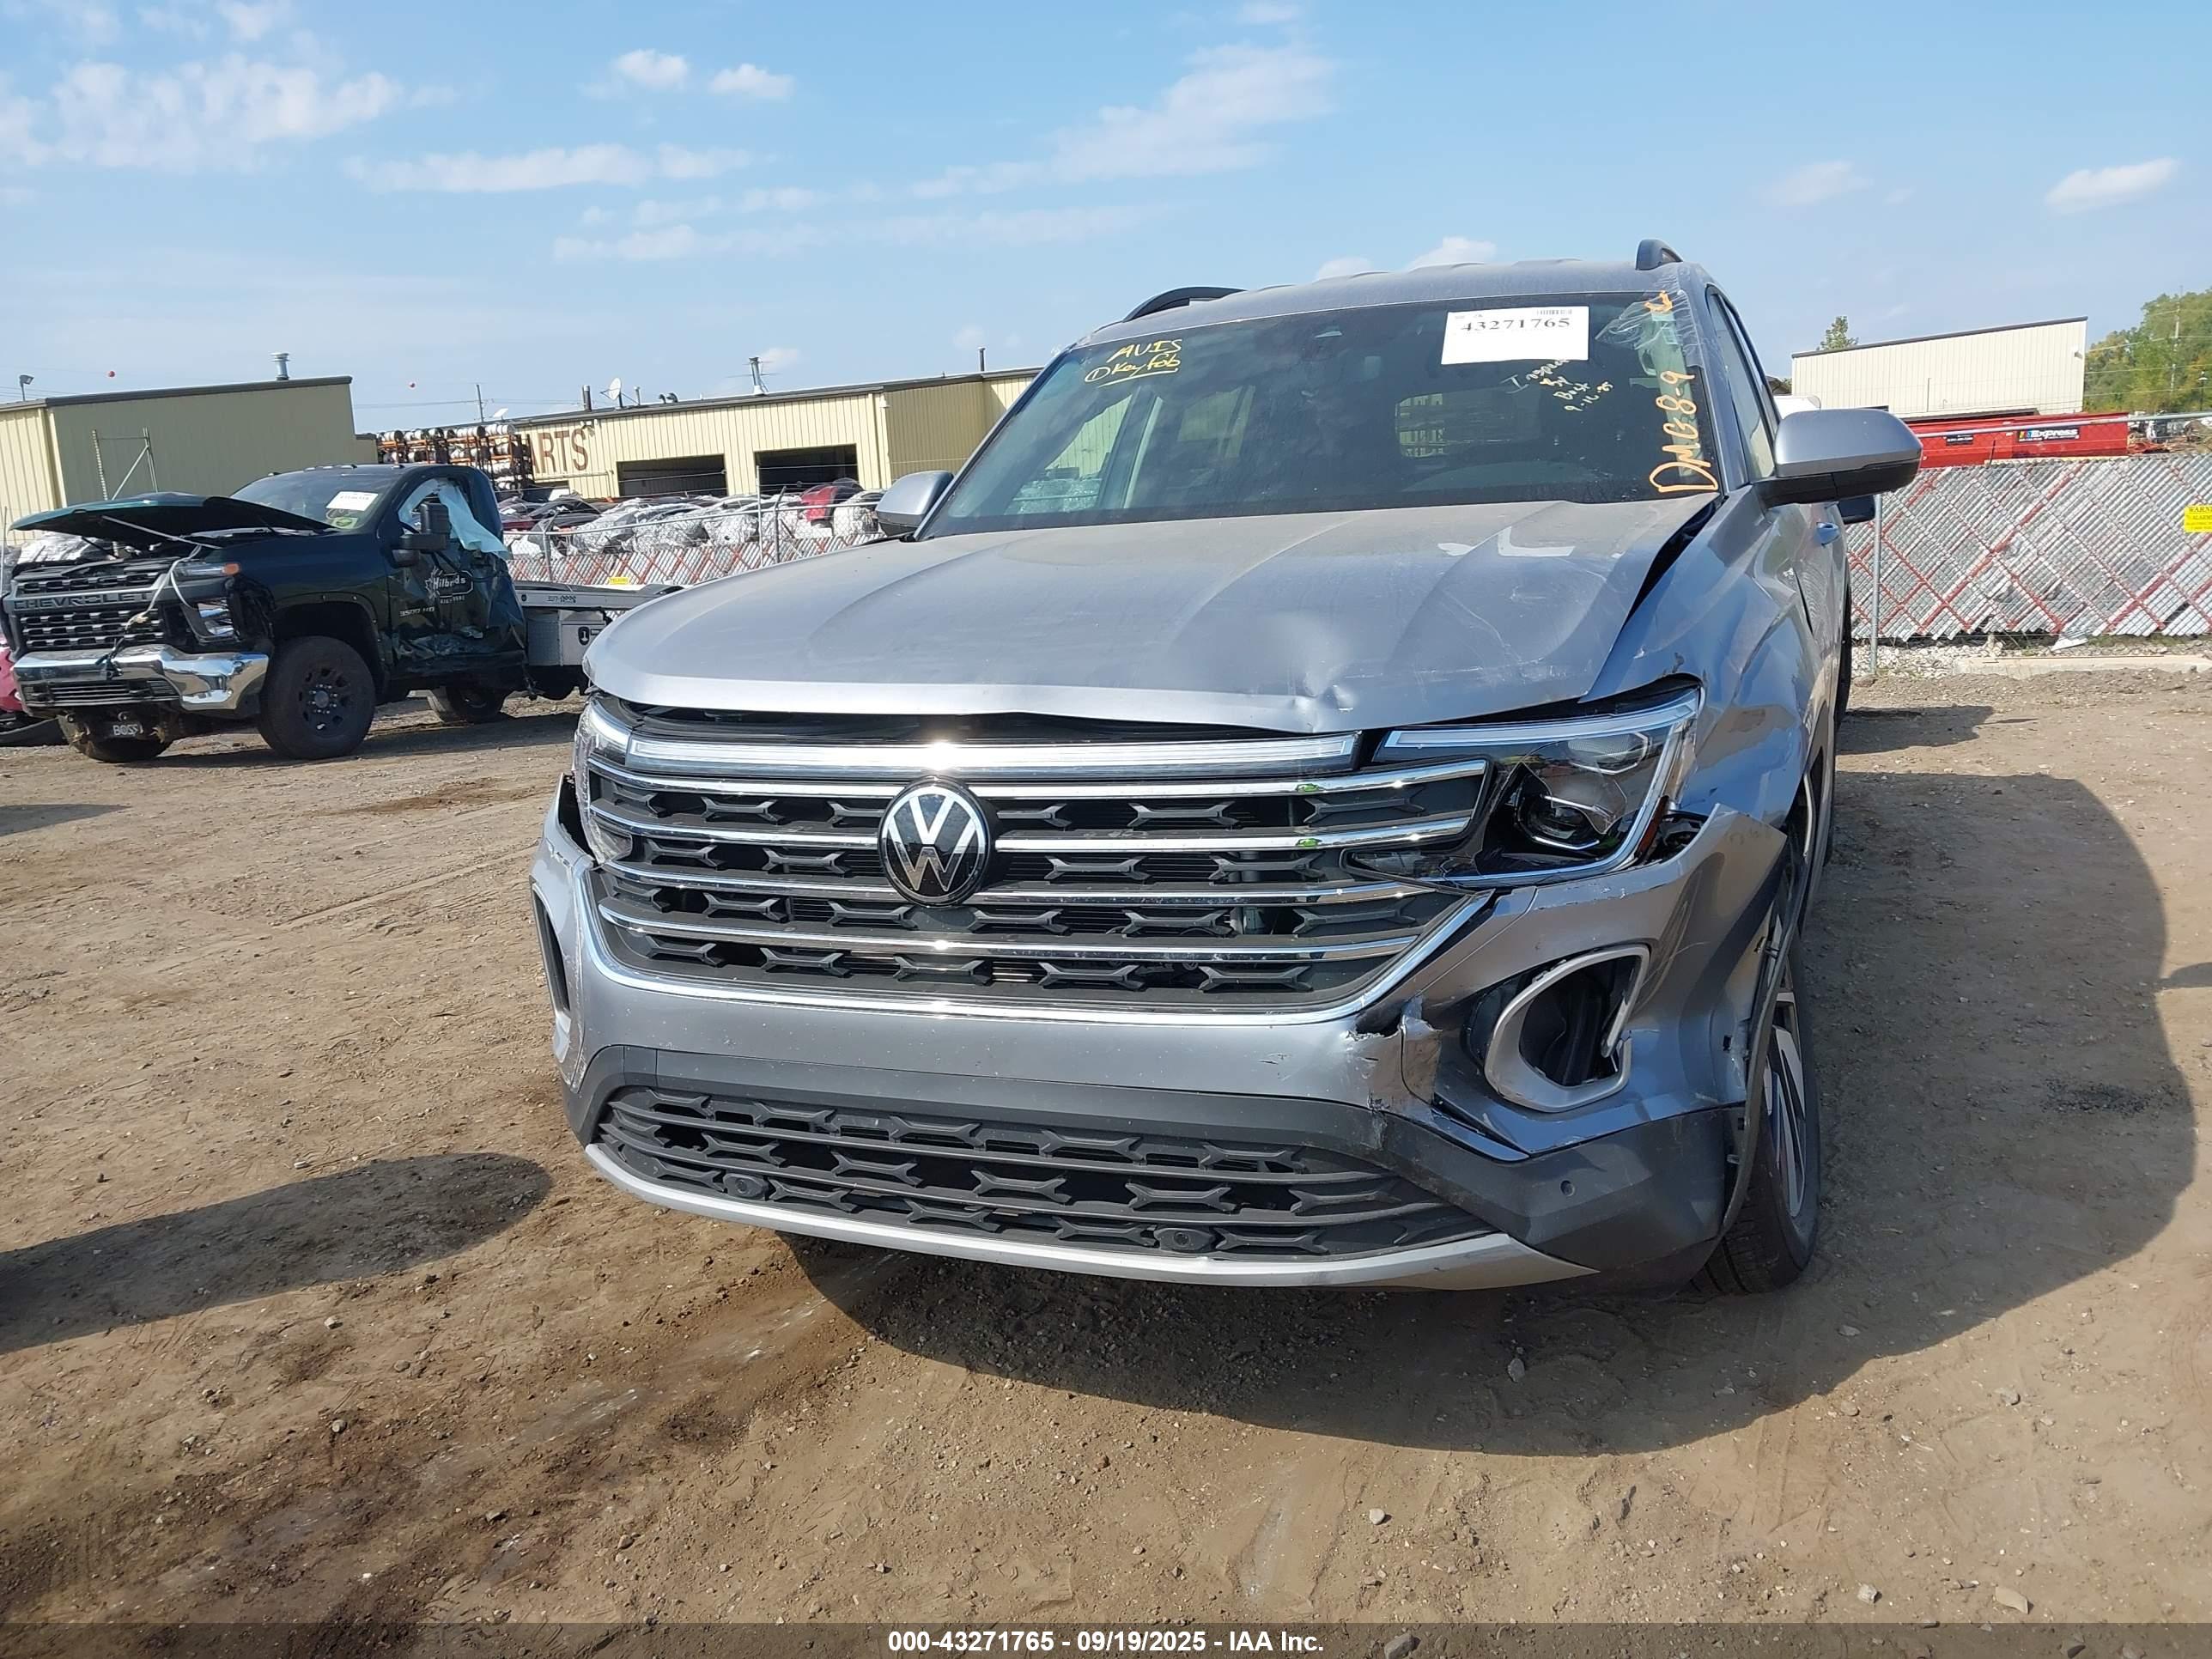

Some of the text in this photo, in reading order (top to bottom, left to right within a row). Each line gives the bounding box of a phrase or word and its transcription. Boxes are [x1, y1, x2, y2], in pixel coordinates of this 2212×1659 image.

[1461, 318, 1571, 331] 43271765
[2031, 429, 2078, 439] Express
[14, 592, 153, 611] CHEVROLET
